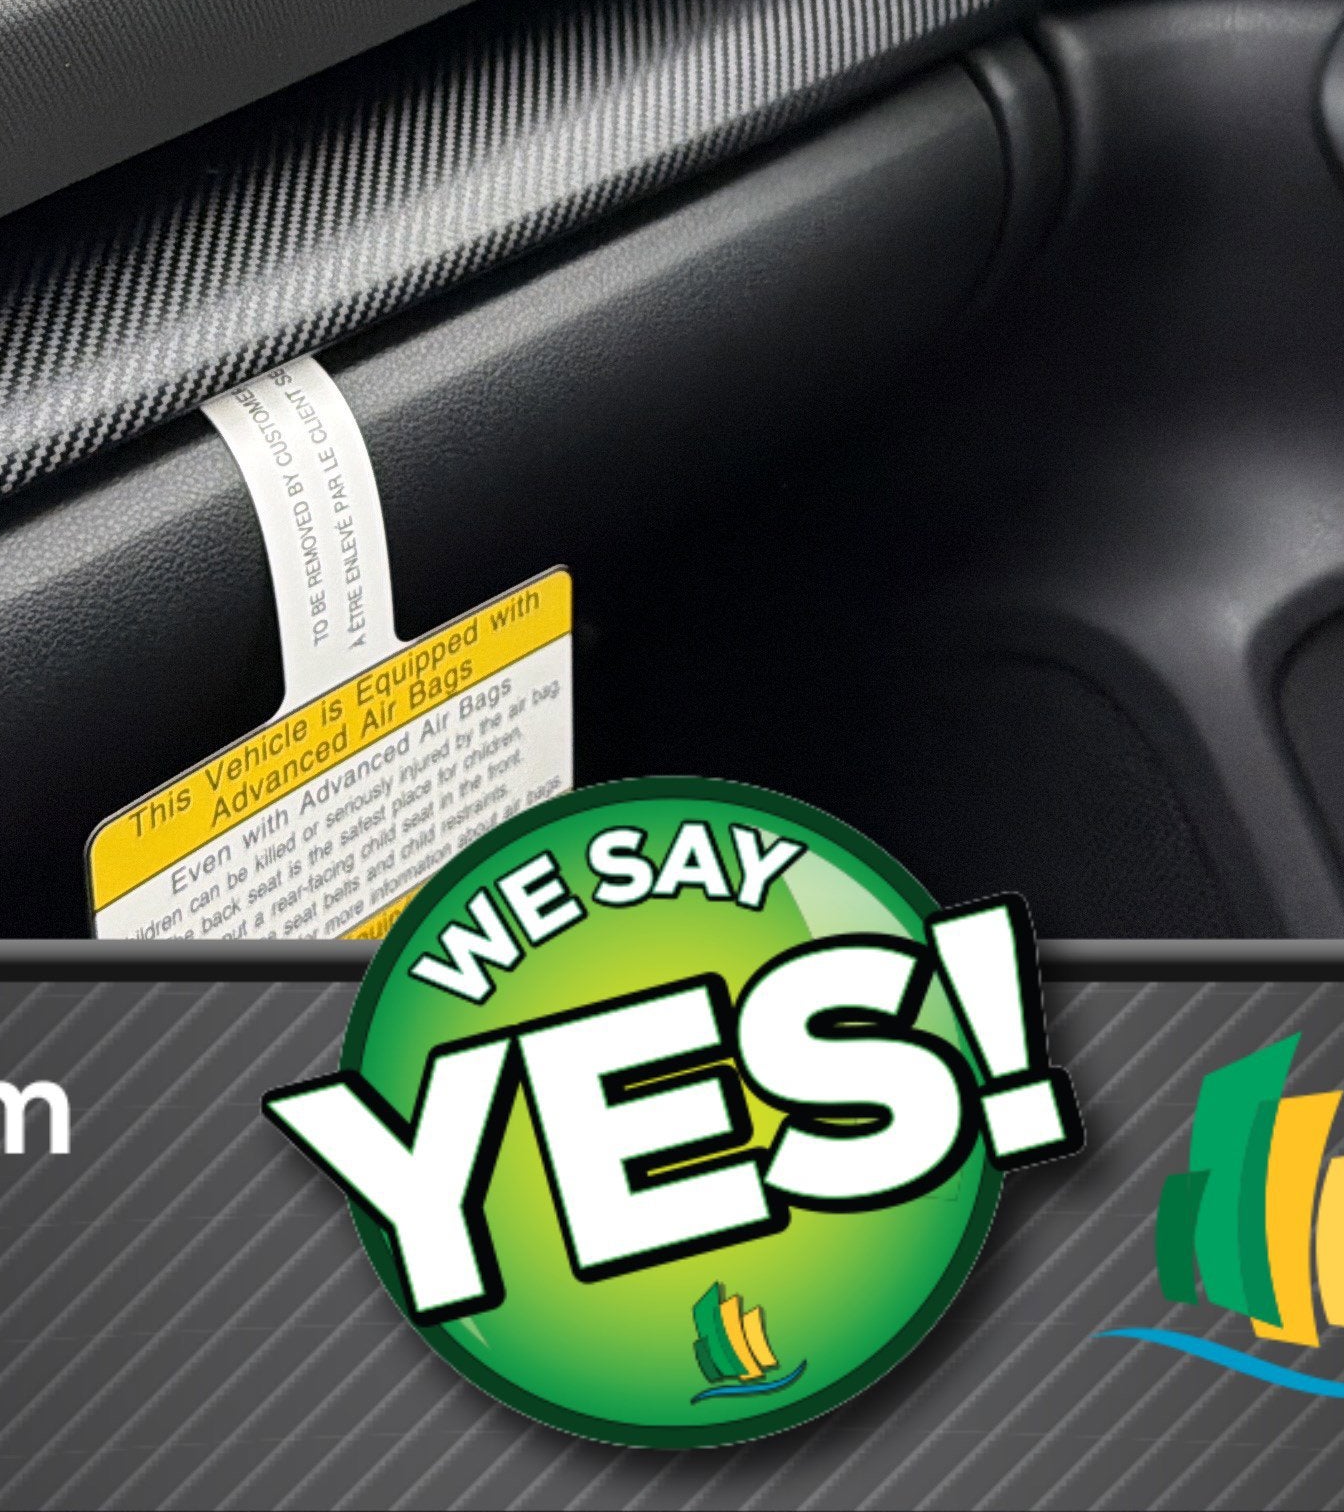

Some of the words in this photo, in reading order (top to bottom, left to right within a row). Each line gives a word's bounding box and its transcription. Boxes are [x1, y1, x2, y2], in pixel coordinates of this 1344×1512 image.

[285, 389, 328, 444] CLIENT
[318, 447, 338, 472] LE
[283, 473, 304, 497] BY
[328, 474, 350, 514] PAR
[293, 500, 323, 588] REMOVED
[310, 589, 327, 617] BE
[312, 619, 330, 647] TO
[129, 787, 192, 837] This
[204, 719, 307, 792] Vehicle
[321, 699, 344, 727] is
[357, 617, 479, 707] Equipped
[489, 590, 540, 632] with
[211, 724, 349, 828] Advanced
[360, 699, 397, 739] Air
[409, 658, 474, 710] Bags
[170, 844, 233, 895] Even
[242, 807, 290, 850] with
[299, 731, 410, 816] Advanced
[419, 711, 451, 743] Air
[458, 677, 512, 721] Bags
[189, 885, 220, 914] can
[227, 866, 249, 890] be
[255, 832, 296, 873] killed
[302, 821, 320, 843] or
[325, 775, 395, 829] seriously
[399, 741, 451, 783] injured
[478, 711, 503, 737] the
[508, 697, 526, 720] air
[202, 896, 242, 935] back
[248, 868, 283, 905] seat
[289, 858, 303, 878] is
[308, 838, 333, 866] the
[340, 804, 387, 847] safest
[391, 778, 433, 817] place
[437, 763, 458, 785] for
[271, 852, 356, 917] rear-facing
[360, 823, 397, 861] child
[402, 801, 435, 834] seat
[458, 775, 483, 799] the
[283, 900, 317, 936] seat
[366, 853, 396, 883] and
[400, 826, 436, 862] child
[324, 899, 365, 936] more
[369, 842, 453, 907] information
